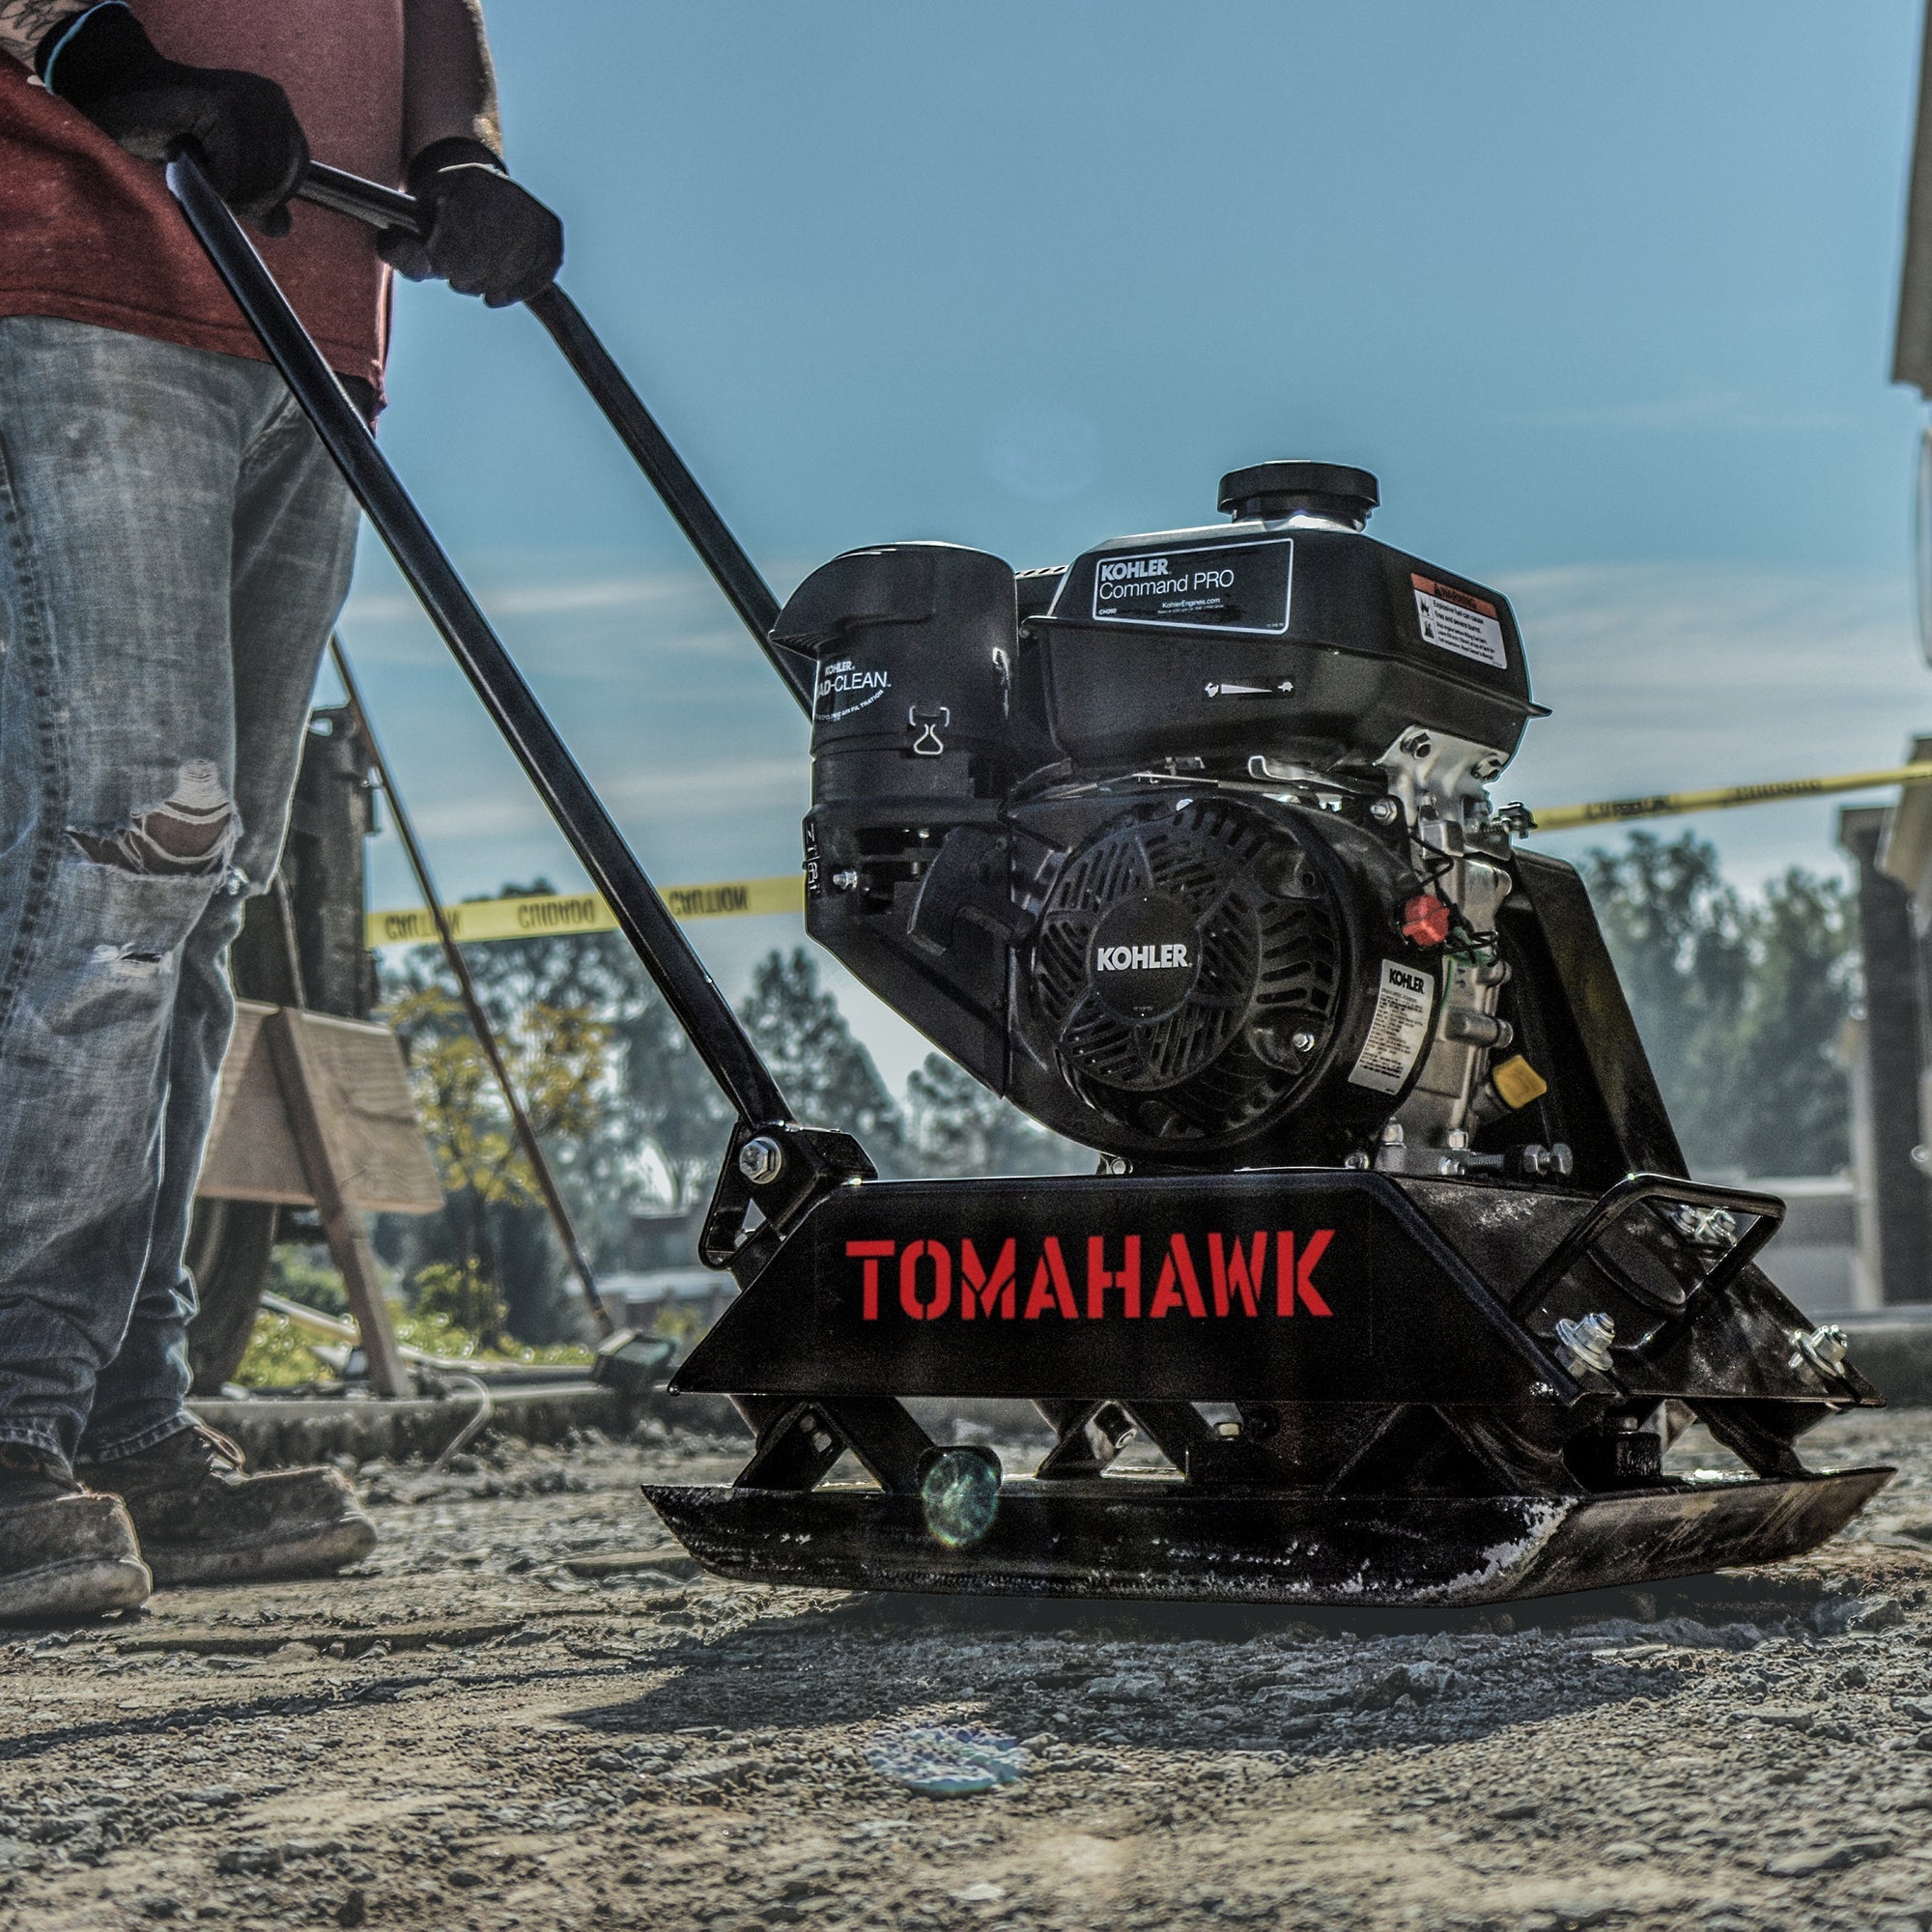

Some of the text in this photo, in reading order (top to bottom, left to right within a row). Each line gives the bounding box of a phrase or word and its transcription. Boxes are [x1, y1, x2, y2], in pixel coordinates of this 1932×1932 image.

[1101, 558, 1169, 582] KOHLER
[1099, 569, 1235, 600] Command PRO
[824, 661, 852, 677] KOHLER
[1096, 944, 1188, 972] KOHLER
[1388, 968, 1425, 995] KOHLER
[845, 1229, 1337, 1321] TOMAHAWK
